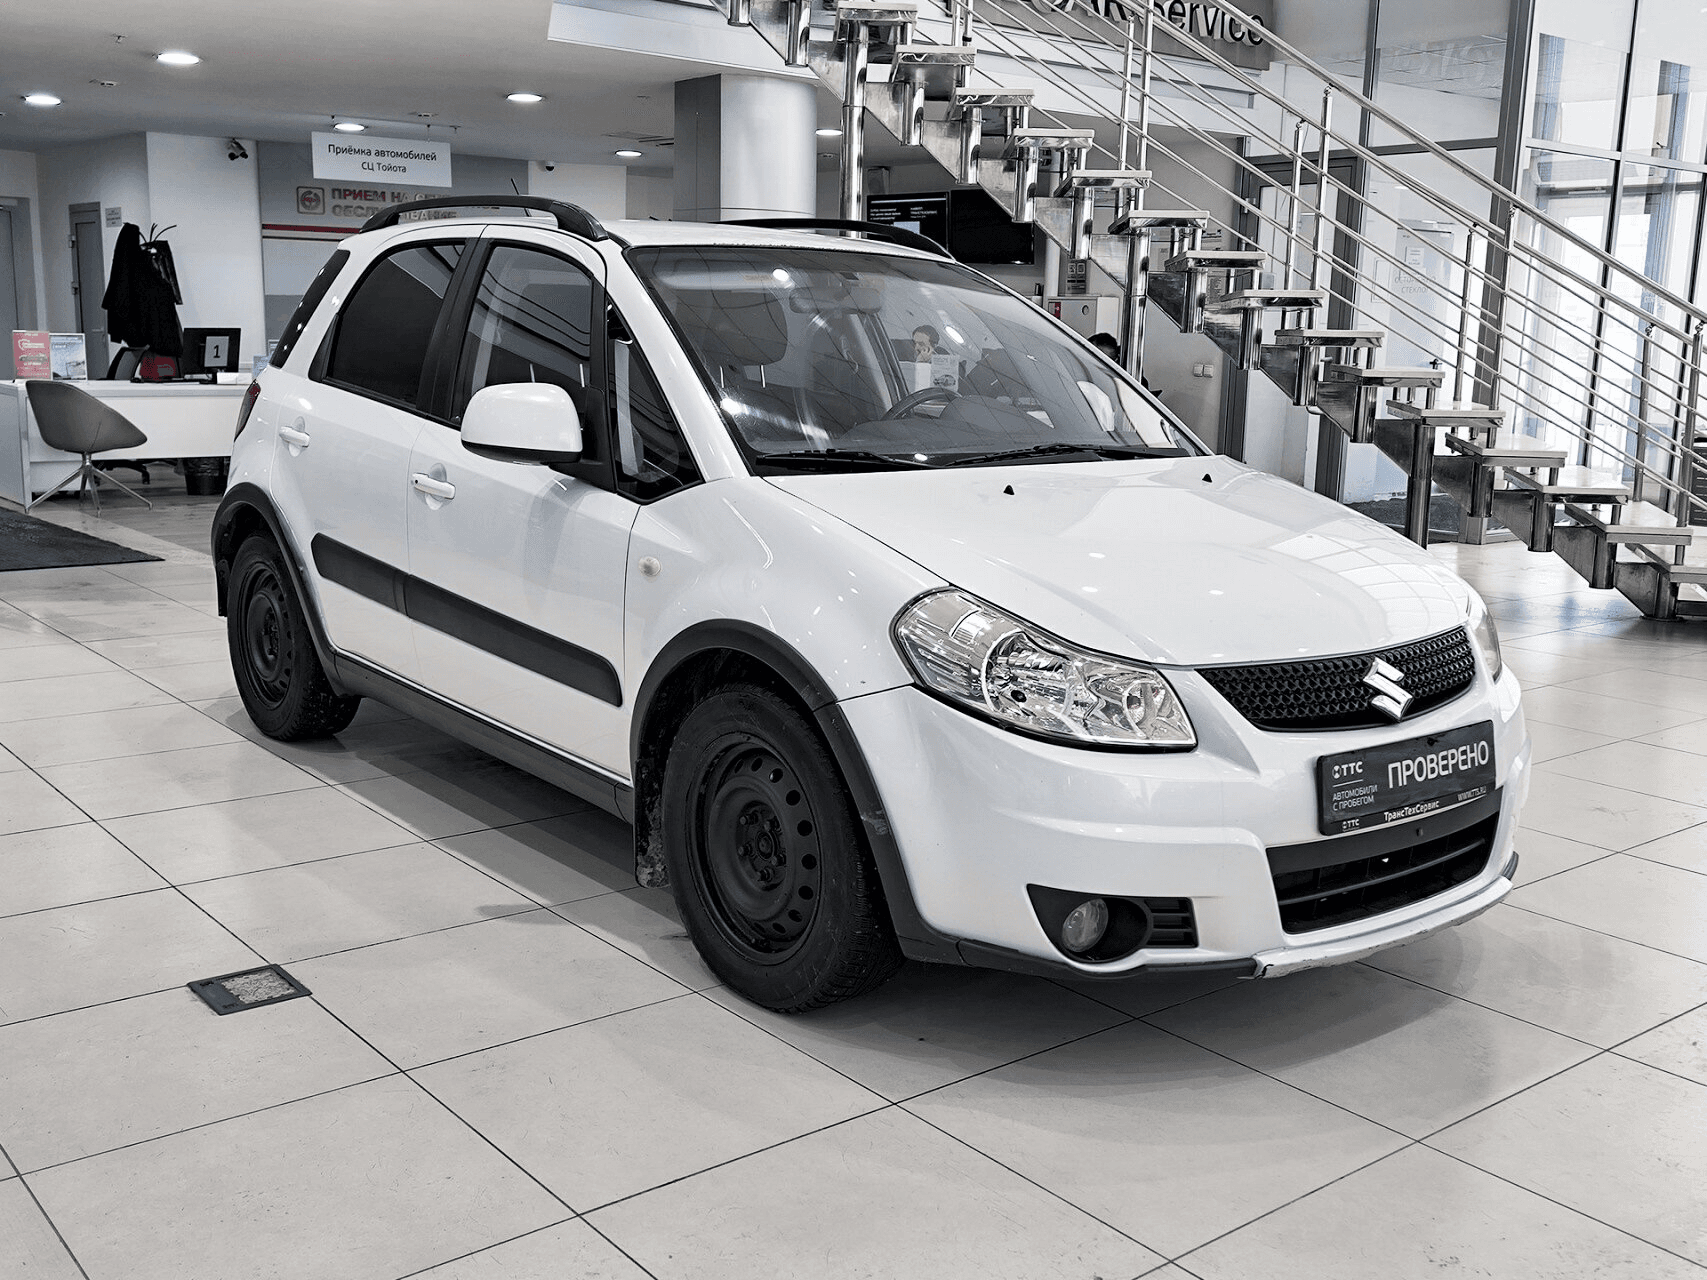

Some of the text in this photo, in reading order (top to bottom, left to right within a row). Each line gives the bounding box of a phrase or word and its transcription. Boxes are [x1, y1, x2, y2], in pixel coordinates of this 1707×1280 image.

[1139, 0, 1264, 45] ervice
[328, 143, 437, 162] Приёмка автомобилей
[361, 162, 407, 173] СЦ Тойота
[331, 188, 386, 202] ПРИЕМ
[213, 345, 221, 358] 1
[1388, 740, 1489, 789] ПРОВЕРЕНО
[1332, 784, 1378, 801] АВТОМОБИЛИ
[1332, 795, 1375, 811] С ПРОБЕГОМ
[1384, 801, 1440, 822] ТрансТехСервис
